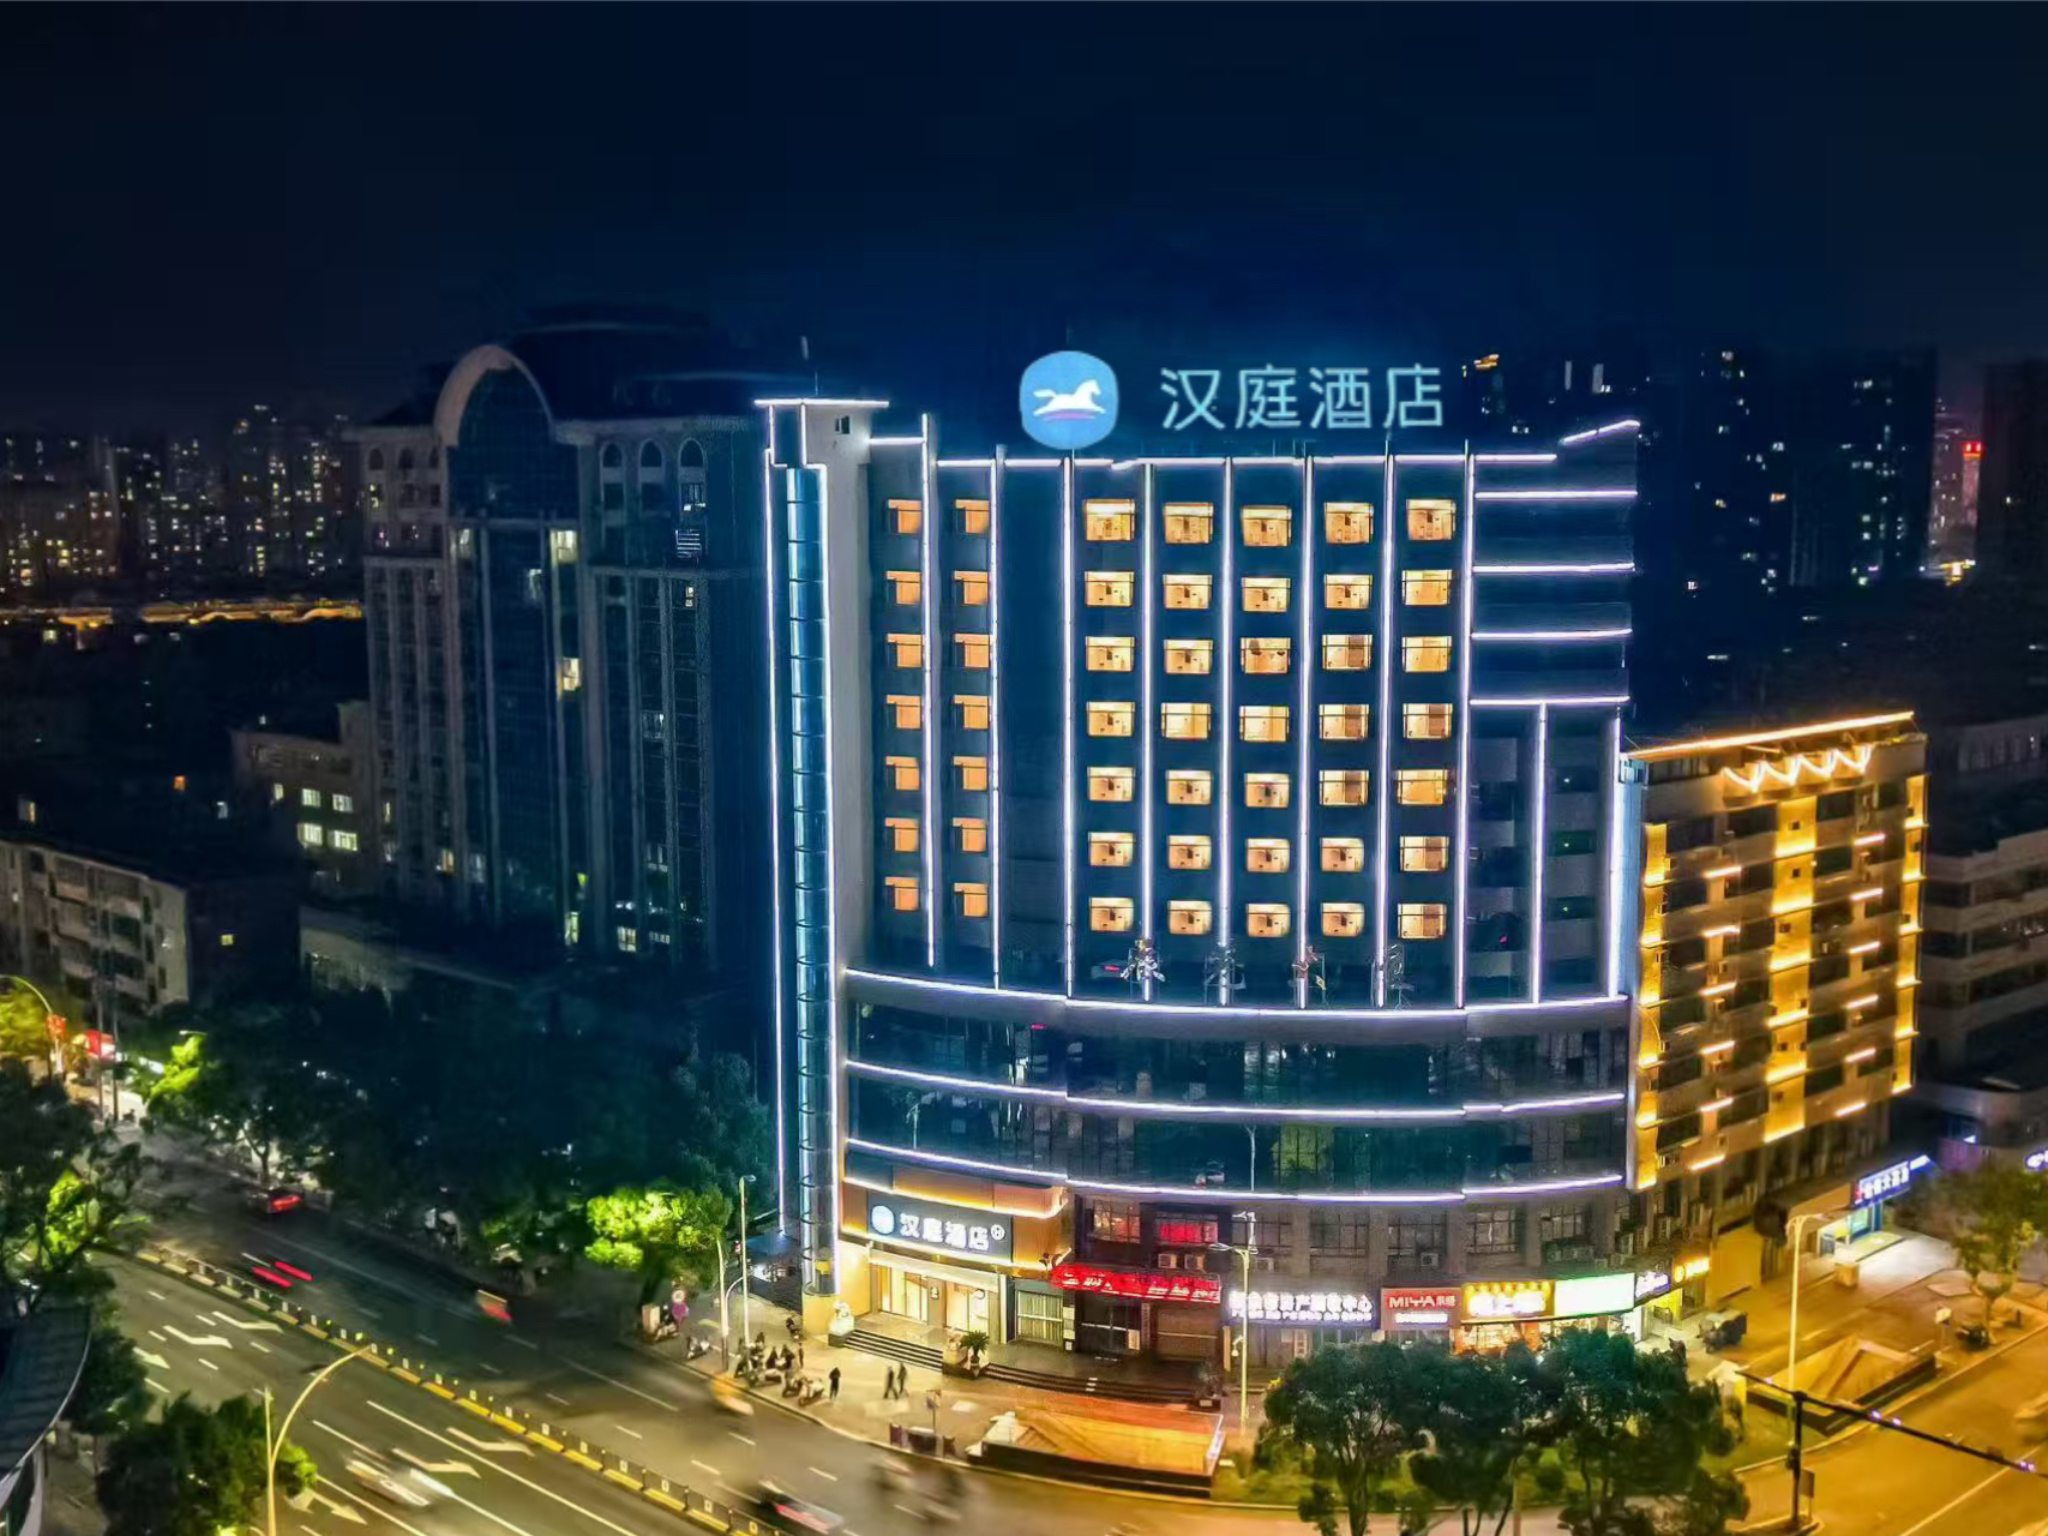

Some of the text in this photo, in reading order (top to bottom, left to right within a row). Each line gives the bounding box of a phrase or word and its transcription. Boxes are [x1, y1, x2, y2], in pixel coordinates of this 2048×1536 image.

[1160, 364, 1443, 430] 汉庭酒店
[899, 1212, 989, 1251] 汉庭酒店
